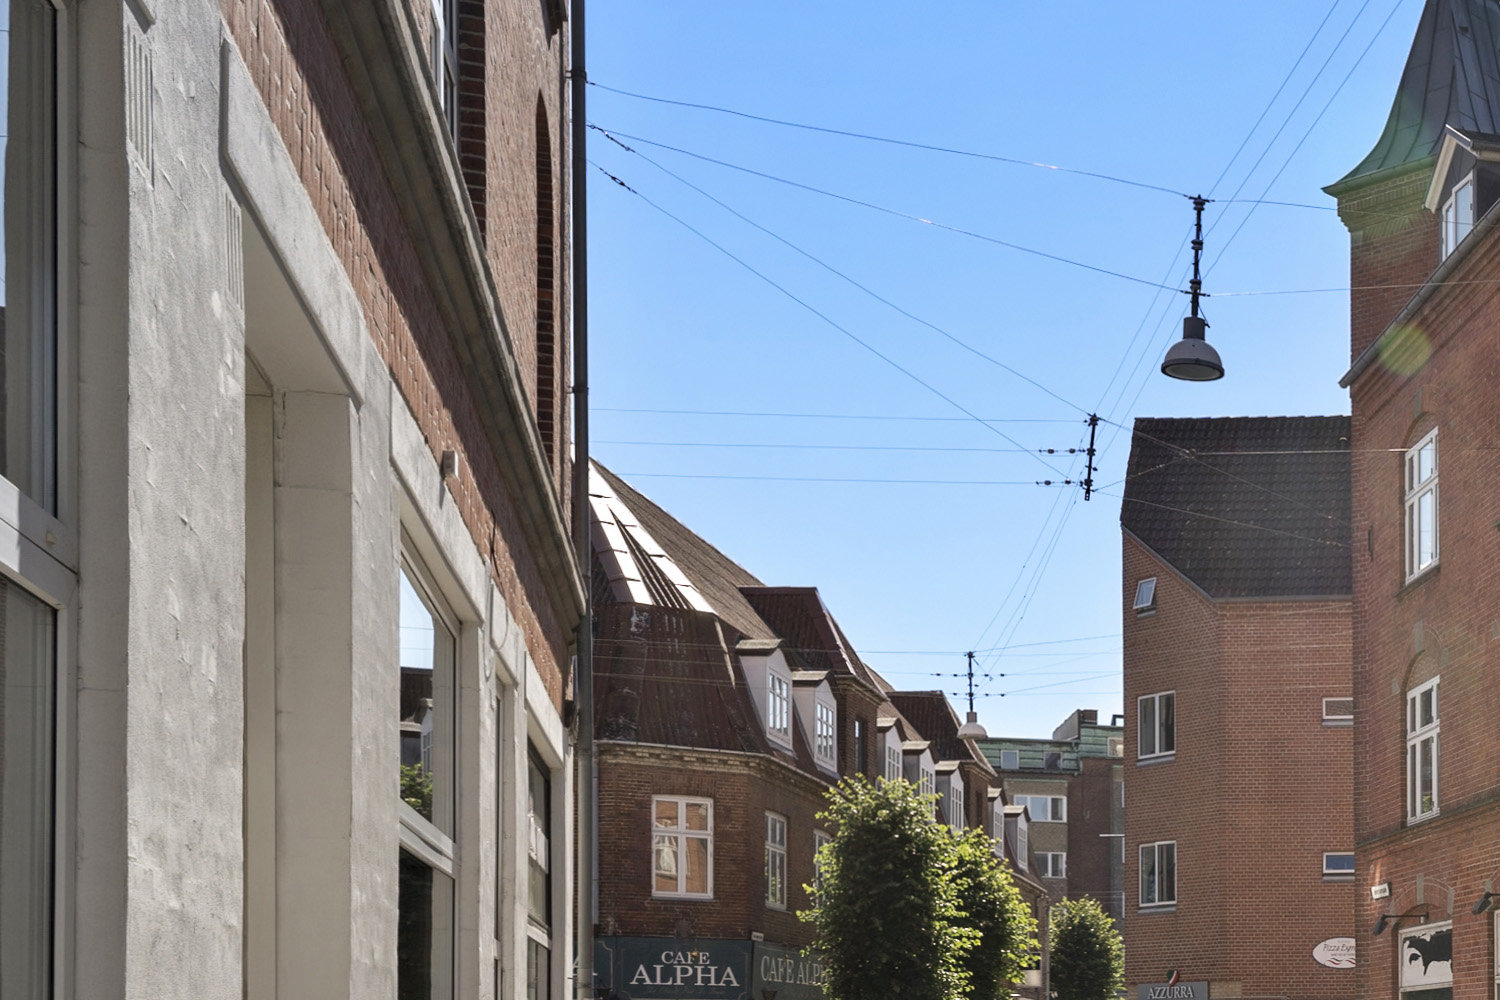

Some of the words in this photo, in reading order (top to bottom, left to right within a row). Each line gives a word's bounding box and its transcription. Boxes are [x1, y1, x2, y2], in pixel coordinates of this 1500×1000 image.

[1323, 943, 1340, 952] Pizza
[1341, 943, 1356, 953] Expr
[661, 950, 711, 965] CAFE
[629, 964, 741, 987] ALPHA
[761, 955, 795, 984] CAFE
[1147, 985, 1194, 1000] AZZURRA
